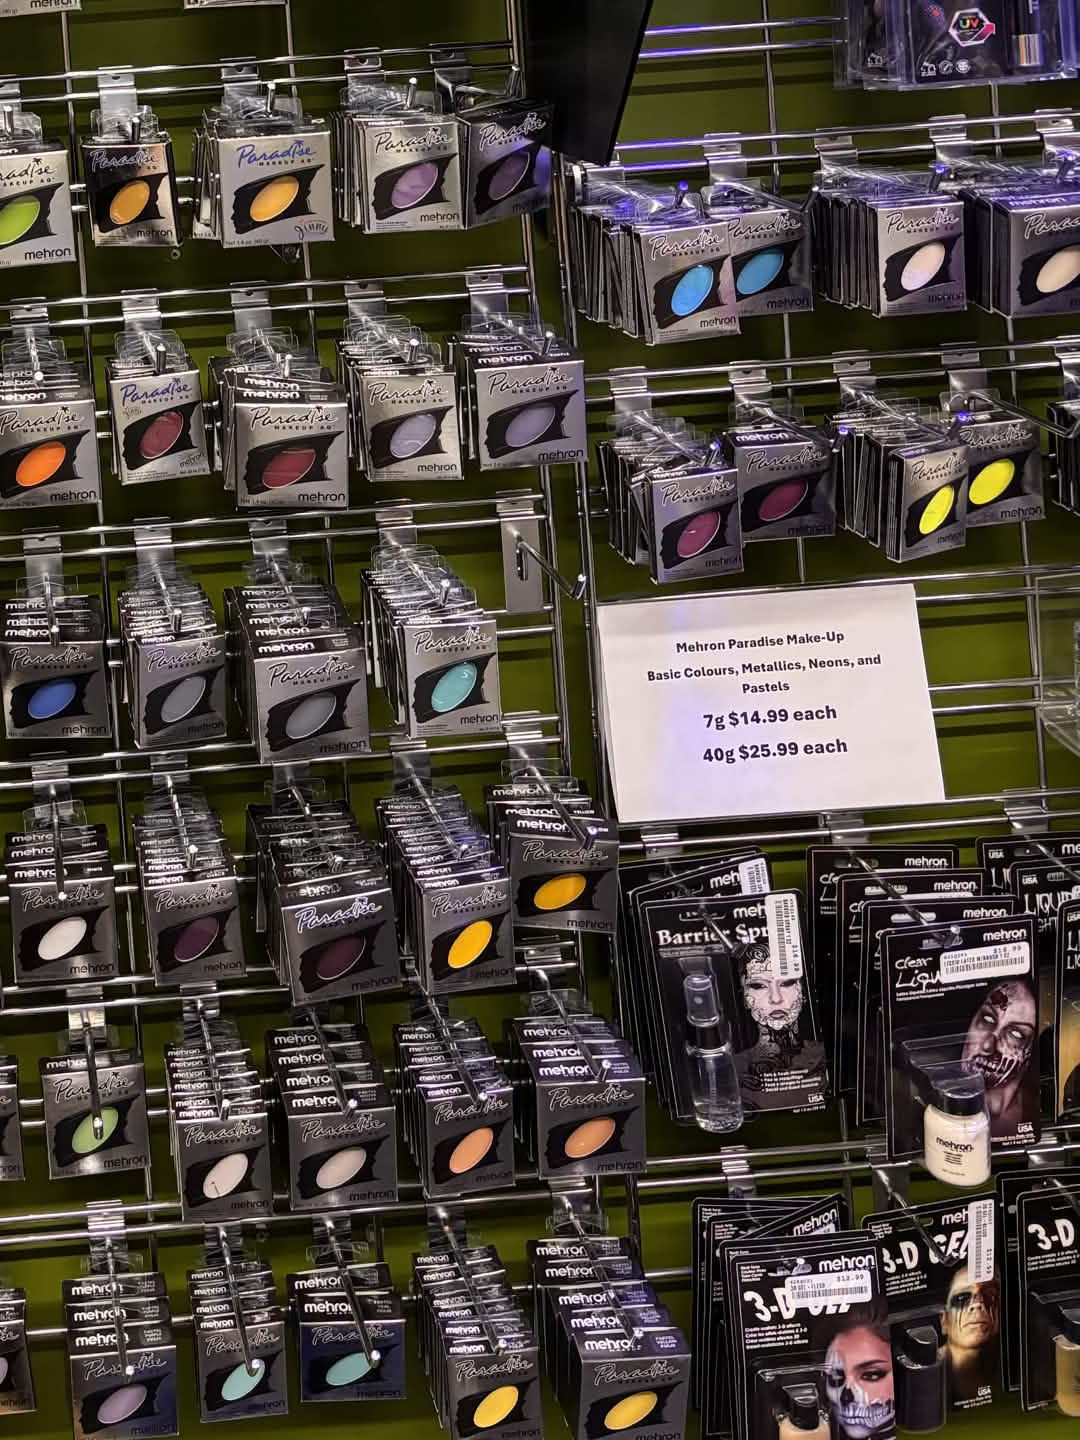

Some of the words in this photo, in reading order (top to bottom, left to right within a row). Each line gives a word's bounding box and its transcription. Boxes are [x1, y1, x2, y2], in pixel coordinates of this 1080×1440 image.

[237, 139, 317, 168] Paradise
[886, 207, 960, 234] Paradise
[24, 247, 72, 261] mehron
[649, 229, 725, 261] Paradise
[0, 407, 85, 436] Paradise
[249, 405, 338, 431] Paradise
[413, 626, 492, 654] Paradise
[676, 640, 726, 654] Mehron
[728, 635, 785, 651] Paradise
[786, 630, 845, 647] Make-Up
[647, 668, 682, 682] Basic
[684, 664, 740, 680] Colours,
[741, 660, 807, 675] Metallics,
[808, 656, 855, 672] Neons,
[856, 653, 882, 667] and
[741, 681, 791, 695] Pastels
[703, 713, 726, 731] 7g
[728, 707, 790, 729] $14.99
[792, 704, 838, 722] each
[703, 746, 737, 765] 40g
[738, 741, 800, 762] $25.99
[802, 738, 849, 756] each
[905, 855, 948, 868] mehron
[296, 897, 382, 932] Paradise
[983, 927, 1028, 942] mehron
[807, 1094, 824, 1104] USA
[1017, 1123, 1033, 1133] USA
[1027, 1218, 1076, 1251] 3-D
[818, 1253, 876, 1273] mehron
[456, 1357, 534, 1384] Paradise
